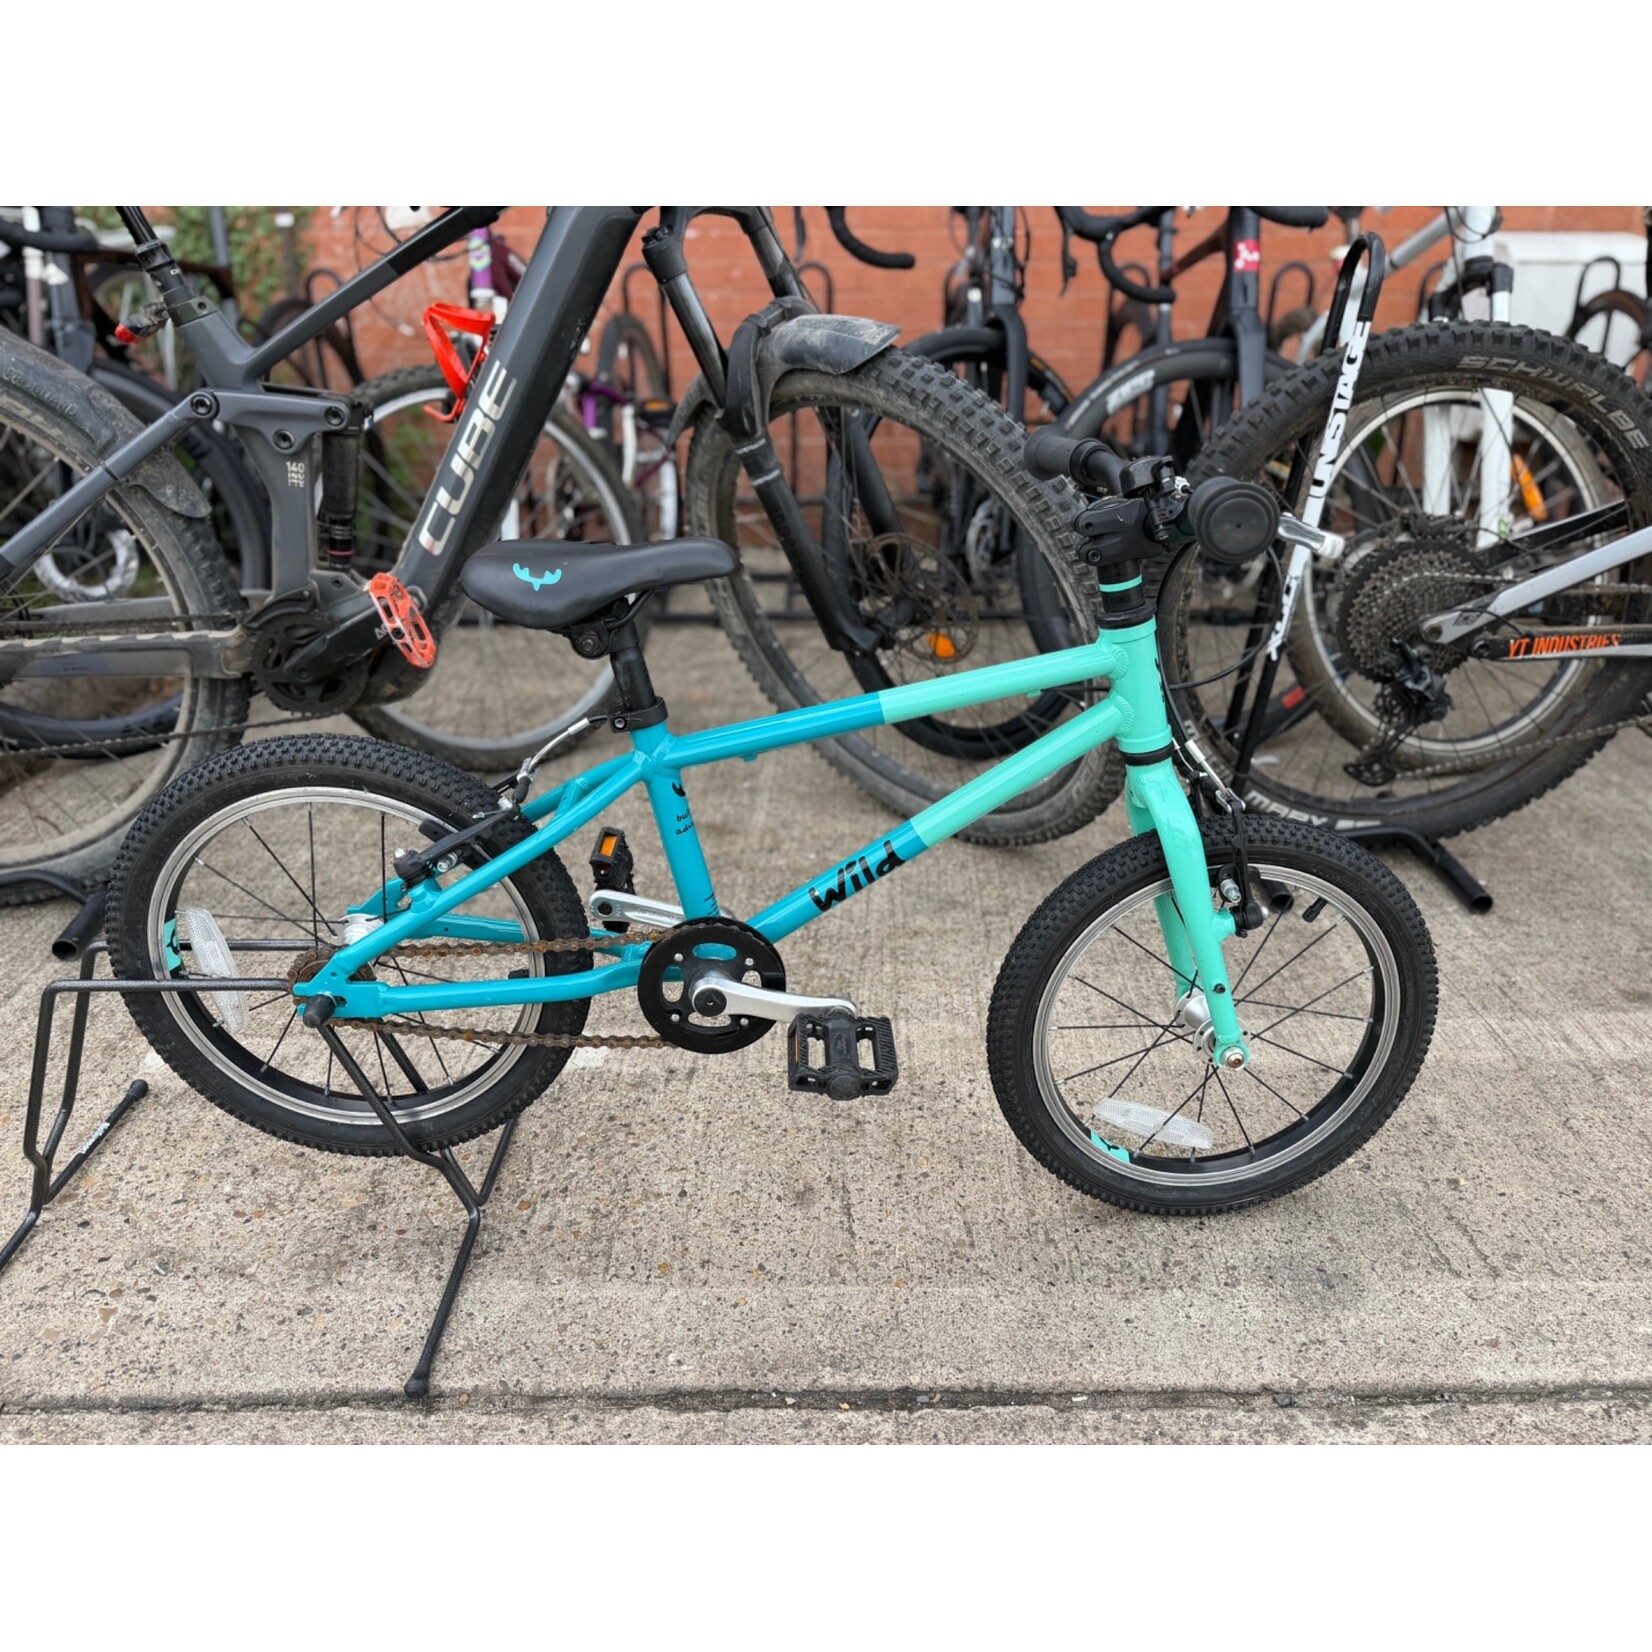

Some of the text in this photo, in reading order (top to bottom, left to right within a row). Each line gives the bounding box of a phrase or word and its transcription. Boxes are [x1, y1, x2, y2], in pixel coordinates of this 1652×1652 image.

[1456, 355, 1650, 450] SCHWALBE
[418, 359, 517, 556] CUBE
[1508, 632, 1622, 660] YT INDUSTRIES
